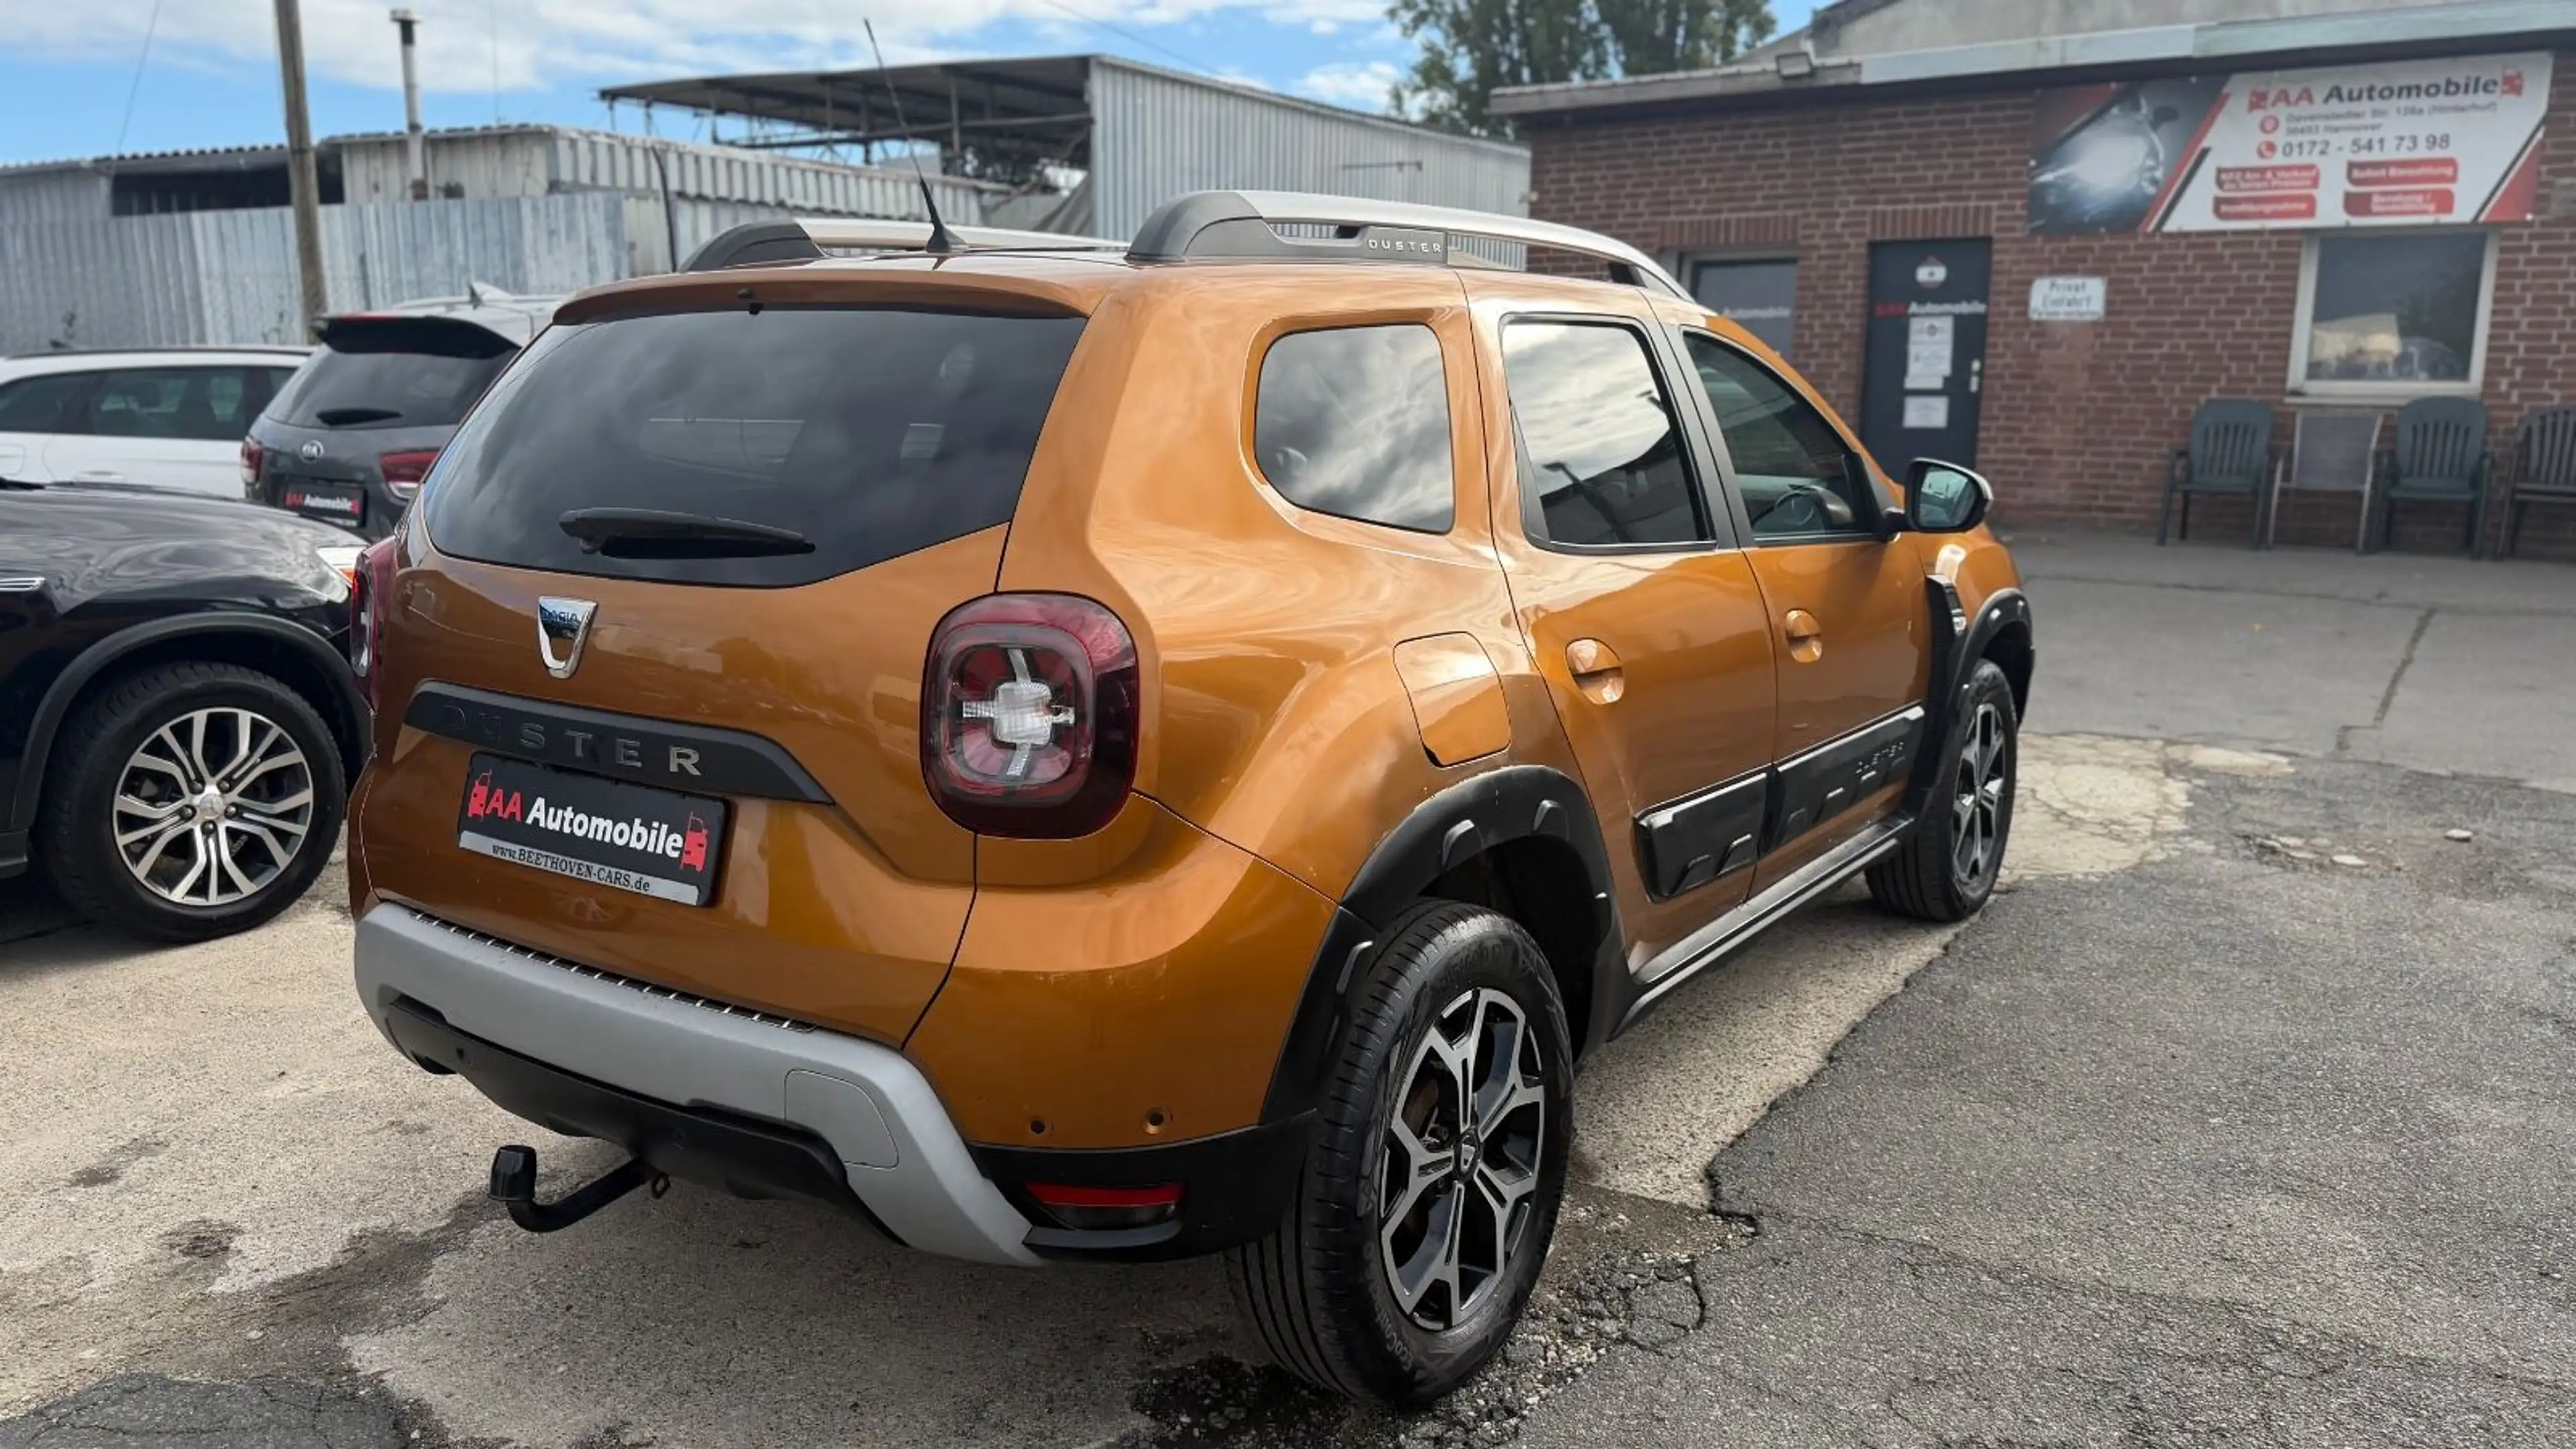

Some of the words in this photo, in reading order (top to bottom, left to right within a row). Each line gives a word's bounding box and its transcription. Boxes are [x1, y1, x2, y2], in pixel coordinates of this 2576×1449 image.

[2271, 87, 2314, 107] AA
[2323, 75, 2500, 104] Automobile
[2282, 140, 2329, 157] 0172
[2350, 137, 2385, 154] 541
[2395, 136, 2418, 152] 73
[2426, 133, 2451, 150] 98
[1368, 239, 1441, 252] DUSTER
[2049, 281, 2086, 294] Privat
[1908, 301, 1986, 314] Automobile
[304, 493, 352, 512] Automobile
[486, 788, 523, 822] AA
[527, 796, 684, 858] Automobile
[492, 843, 651, 892] www.BEETHOVEN-CARS.de
